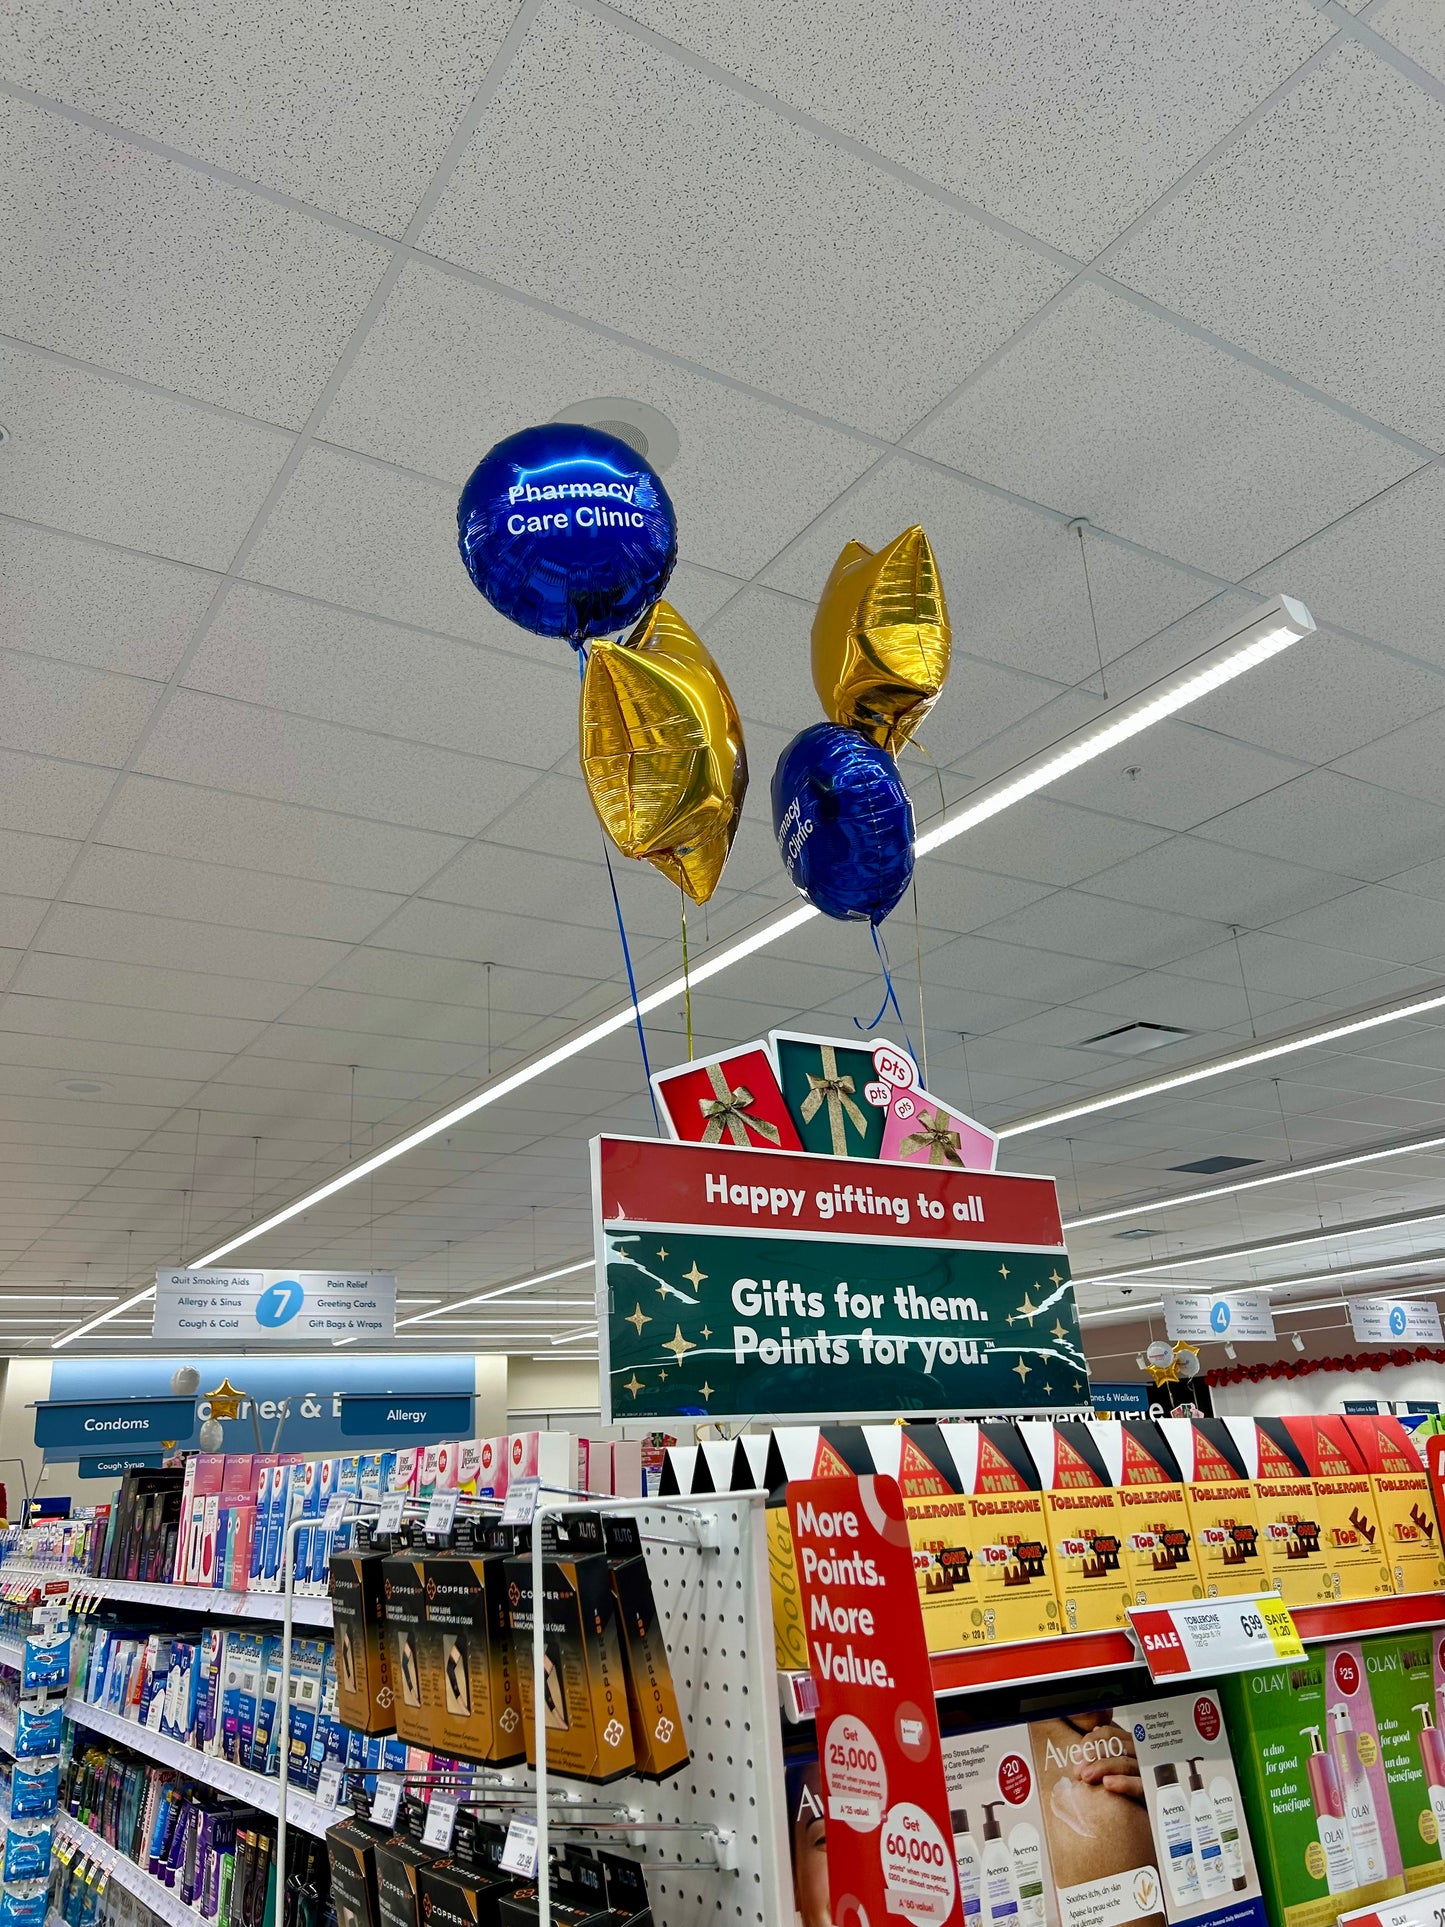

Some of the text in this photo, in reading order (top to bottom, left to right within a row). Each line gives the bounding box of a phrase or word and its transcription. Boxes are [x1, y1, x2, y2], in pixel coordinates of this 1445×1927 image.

[508, 482, 634, 505] Pharmacy
[507, 506, 645, 535] Care Clinic
[788, 818, 814, 859] Clinic
[880, 1056, 906, 1081] pts
[869, 1086, 888, 1103] pts
[898, 1101, 912, 1117] pts
[705, 1173, 985, 1225] Happy gifting to all
[171, 1276, 250, 1287] Quit Smoking Aids
[327, 1280, 368, 1289] Pain Relief
[178, 1297, 242, 1308] Allergy & Sinus
[272, 1289, 292, 1318] 7
[317, 1299, 376, 1309] Greeting Cards
[731, 1278, 989, 1321] Gifts for them.
[178, 1319, 239, 1330] Cough & Cold
[308, 1319, 382, 1329] Gift Bags & Wraps
[1216, 1307, 1227, 1327] 4
[1393, 1311, 1404, 1330] 3
[733, 1326, 850, 1365] Points
[859, 1328, 909, 1364] for
[1106, 1393, 1111, 1402] &
[1113, 1393, 1139, 1402] Walkers
[387, 1408, 427, 1423] Allergy
[84, 1418, 149, 1432] Condoms
[97, 1461, 145, 1471] Cough Syrup
[1253, 1483, 1313, 1498] TOBLERONE
[1312, 1481, 1369, 1496] TOBLERONE
[1374, 1478, 1427, 1492] TOBLERONE
[1116, 1490, 1183, 1507] TOBLERONE
[1189, 1486, 1251, 1502] TOBLERONE
[968, 1499, 1041, 1517] TOBLERONE
[1048, 1495, 1115, 1511] TOBLERONE
[796, 1501, 859, 1538] More
[1132, 1535, 1155, 1549] TOB
[1164, 1533, 1185, 1545] ONE
[1203, 1529, 1225, 1543] TOB
[1018, 1545, 1041, 1559] ONE
[1063, 1540, 1085, 1555] TOB
[1095, 1539, 1116, 1552] ONE
[941, 1551, 967, 1565] ONE
[983, 1547, 1008, 1562] TOB
[801, 1548, 885, 1586] Points.
[810, 1594, 875, 1636] More
[1184, 1613, 1220, 1625] TOBLERONE
[1264, 1613, 1289, 1626] SAVE
[1199, 1623, 1221, 1631] ASSORTED
[1273, 1625, 1291, 1637] 1.20
[1143, 1631, 1180, 1651] SALE
[813, 1642, 896, 1688] Value.
[1366, 1654, 1397, 1673] OLAY
[1339, 1667, 1354, 1680] $25
[1252, 1672, 1285, 1694] OLAY
[1157, 1711, 1169, 1719] Body
[1197, 1702, 1211, 1715] $20
[1157, 1720, 1174, 1729] Regimen
[1378, 1718, 1398, 1731] a duo
[843, 1727, 858, 1741] Get
[1148, 1732, 1164, 1740] Routine
[1381, 1730, 1410, 1748] for good
[829, 1743, 877, 1772] 25,000
[953, 1748, 970, 1758] Stress
[1263, 1744, 1285, 1757] a duo
[948, 1760, 962, 1769] Care
[962, 1756, 986, 1767] Regimen
[1002, 1759, 1020, 1777] $20
[1265, 1758, 1298, 1775] for good
[1385, 1755, 1410, 1768] un duo
[965, 1770, 979, 1778] soins
[1387, 1768, 1423, 1784] bénéfique
[1270, 1783, 1297, 1798] un duo
[1272, 1796, 1311, 1815] bénéfique
[1351, 1803, 1370, 1819] OLAY
[903, 1816, 920, 1832] Get
[1324, 1828, 1345, 1843] OLAY
[886, 1833, 944, 1867] 60,000
[516, 1853, 533, 1868] 22.99
[907, 1868, 920, 1876] when
[921, 1871, 930, 1879] you
[931, 1873, 947, 1883] spend
[908, 1878, 925, 1888] almost
[1065, 1890, 1088, 1905] Soothes
[1110, 1882, 1122, 1892] skin
[898, 1899, 904, 1907] A
[915, 1902, 935, 1913] value!
[1069, 1905, 1087, 1919] Apaise
[1087, 1903, 1093, 1912] la
[1092, 1901, 1106, 1913] peau
[1392, 1915, 1407, 1927] OLAY
